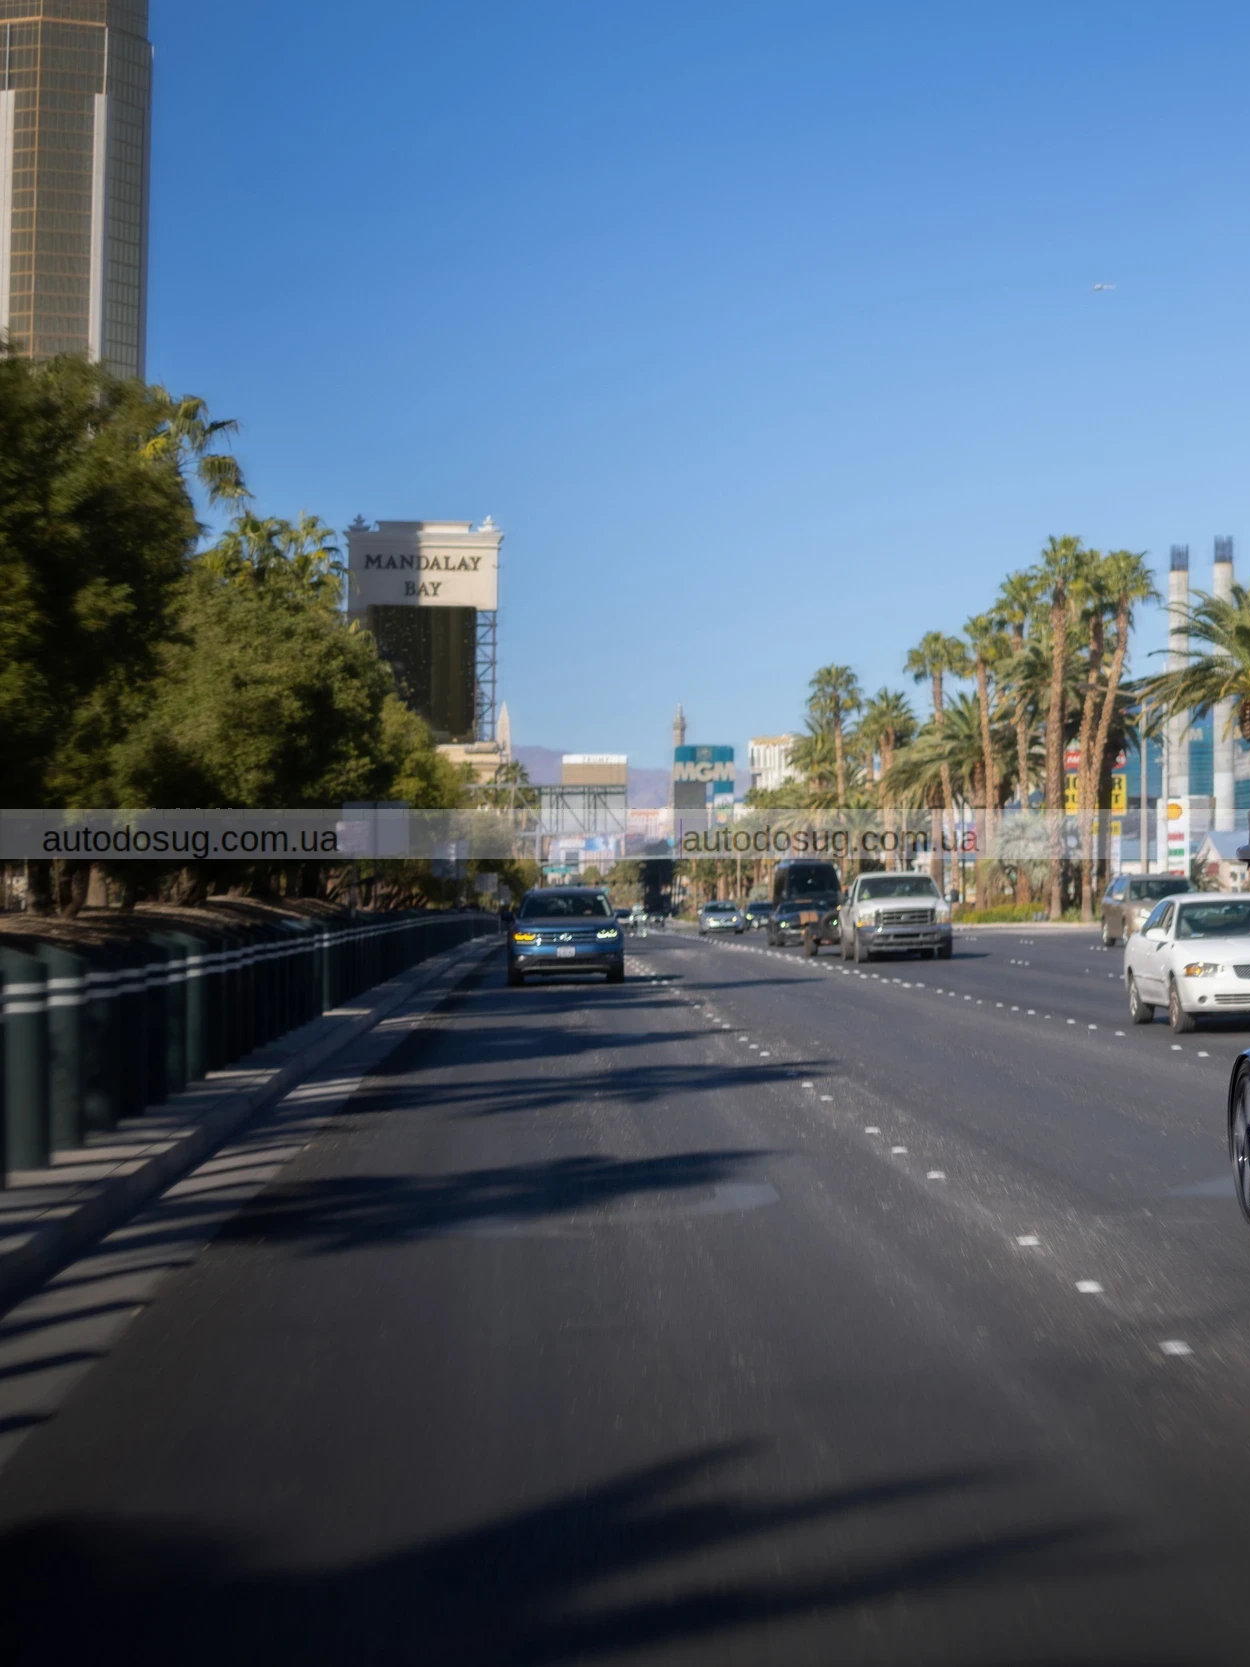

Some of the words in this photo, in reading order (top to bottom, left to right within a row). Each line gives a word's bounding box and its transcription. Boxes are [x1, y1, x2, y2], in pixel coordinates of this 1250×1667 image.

[364, 554, 482, 571] MANDALAY
[404, 580, 442, 597] BAY
[673, 761, 736, 783] MGM
